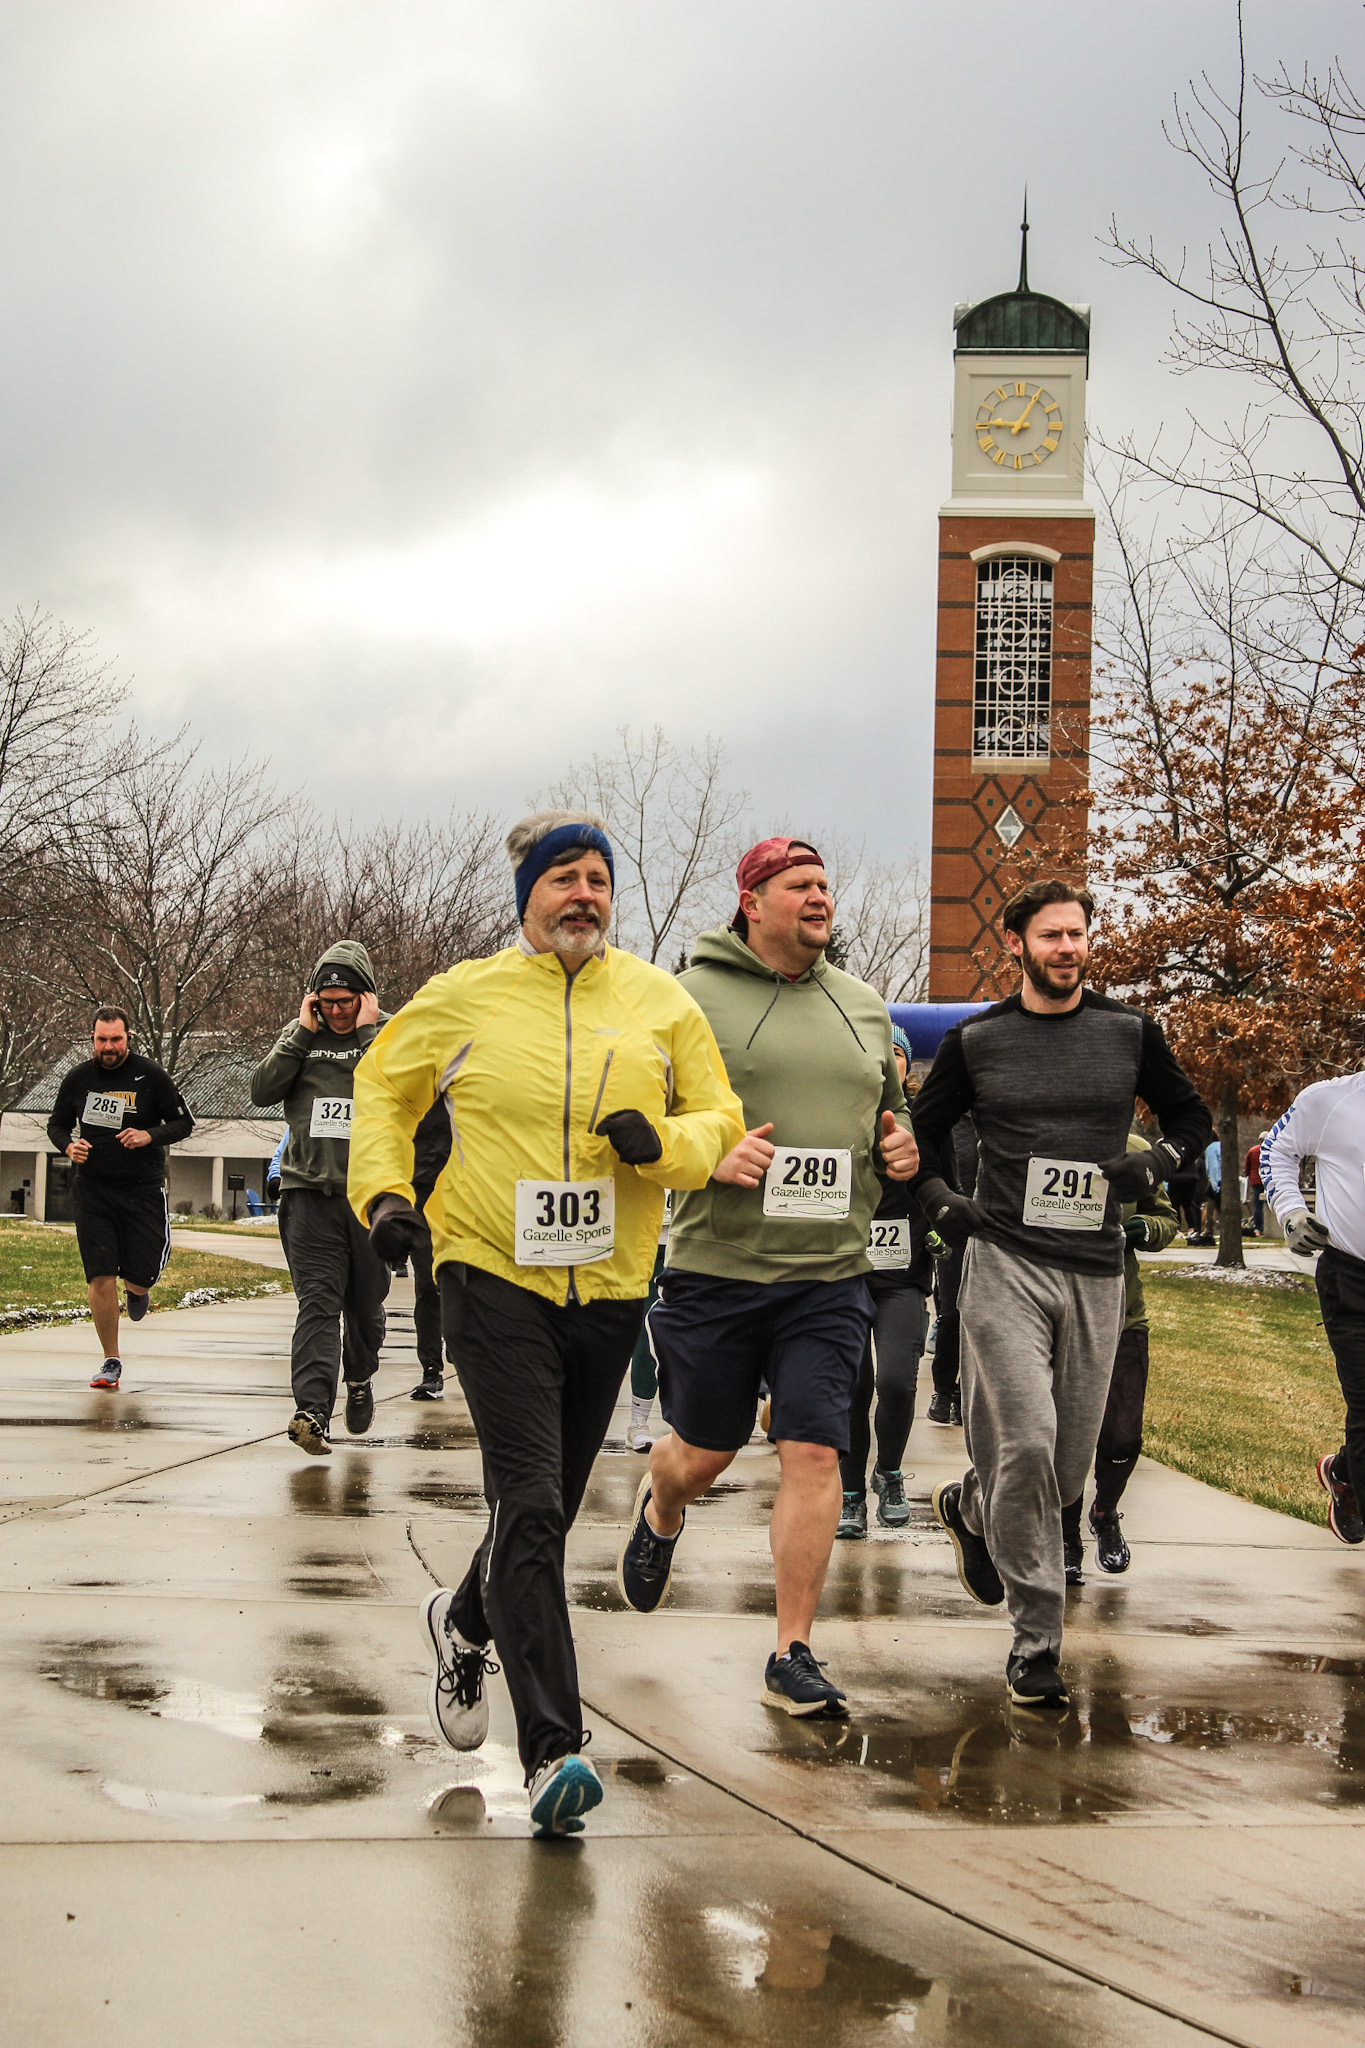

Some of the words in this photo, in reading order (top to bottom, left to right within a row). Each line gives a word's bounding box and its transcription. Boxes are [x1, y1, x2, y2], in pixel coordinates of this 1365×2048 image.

[92, 1096, 118, 1114] 285
[321, 1102, 352, 1120] 321
[313, 1119, 337, 1127] Gazelle
[782, 1156, 837, 1187] 289
[1042, 1167, 1093, 1199] 291
[771, 1186, 812, 1198] Gazelle
[813, 1188, 847, 1201] Sports
[536, 1189, 600, 1228] 303
[1030, 1196, 1071, 1210] Gazelle
[1072, 1200, 1103, 1213] Sports
[523, 1228, 573, 1242] Gazelle
[576, 1225, 611, 1244] Sports
[884, 1248, 909, 1257] Sports
